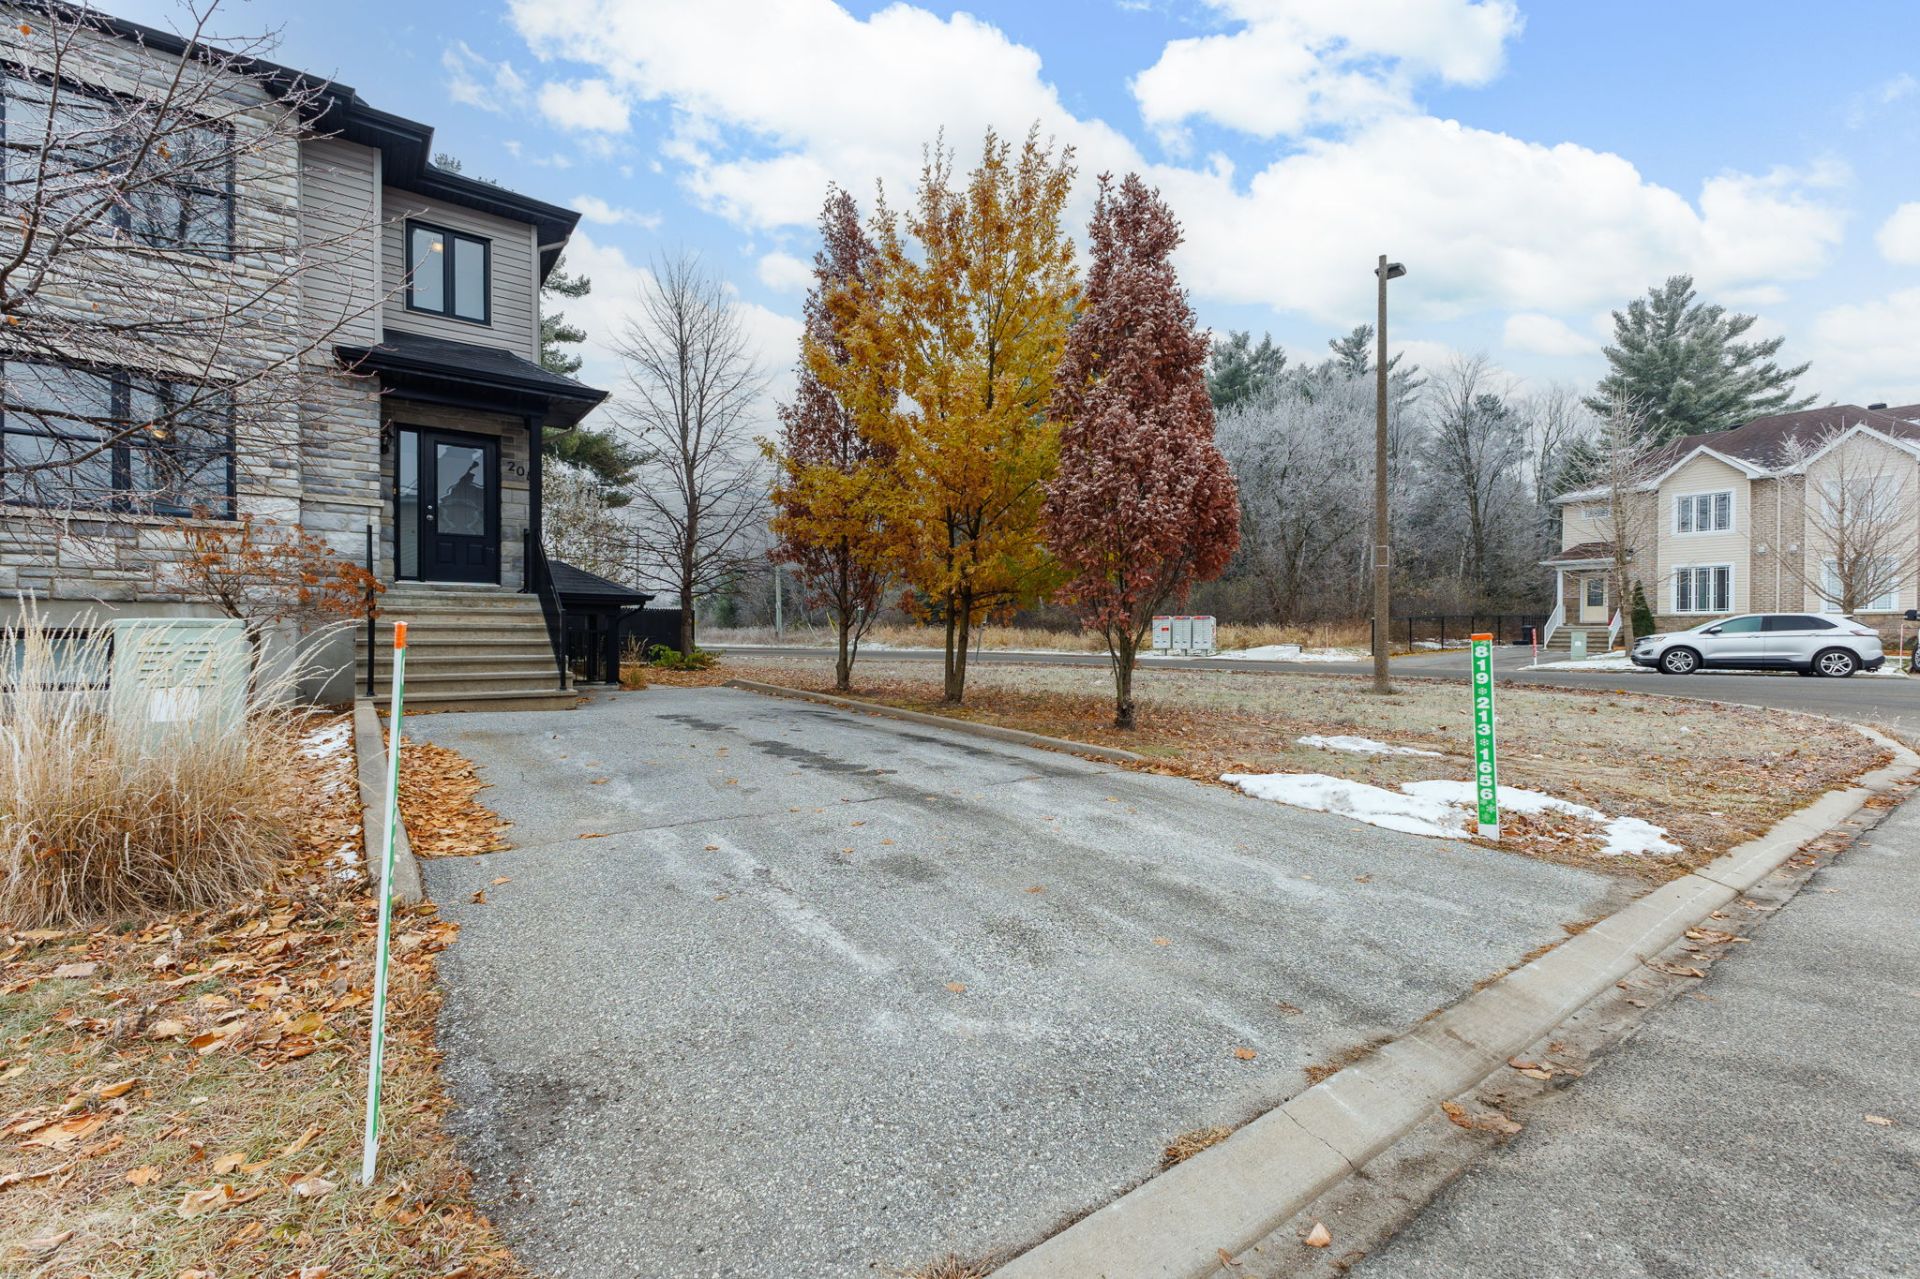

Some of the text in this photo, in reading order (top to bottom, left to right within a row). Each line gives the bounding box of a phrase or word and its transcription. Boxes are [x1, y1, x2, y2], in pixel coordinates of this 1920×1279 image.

[507, 461, 529, 480] 20
[1475, 646, 1494, 800] 819 213 1656
